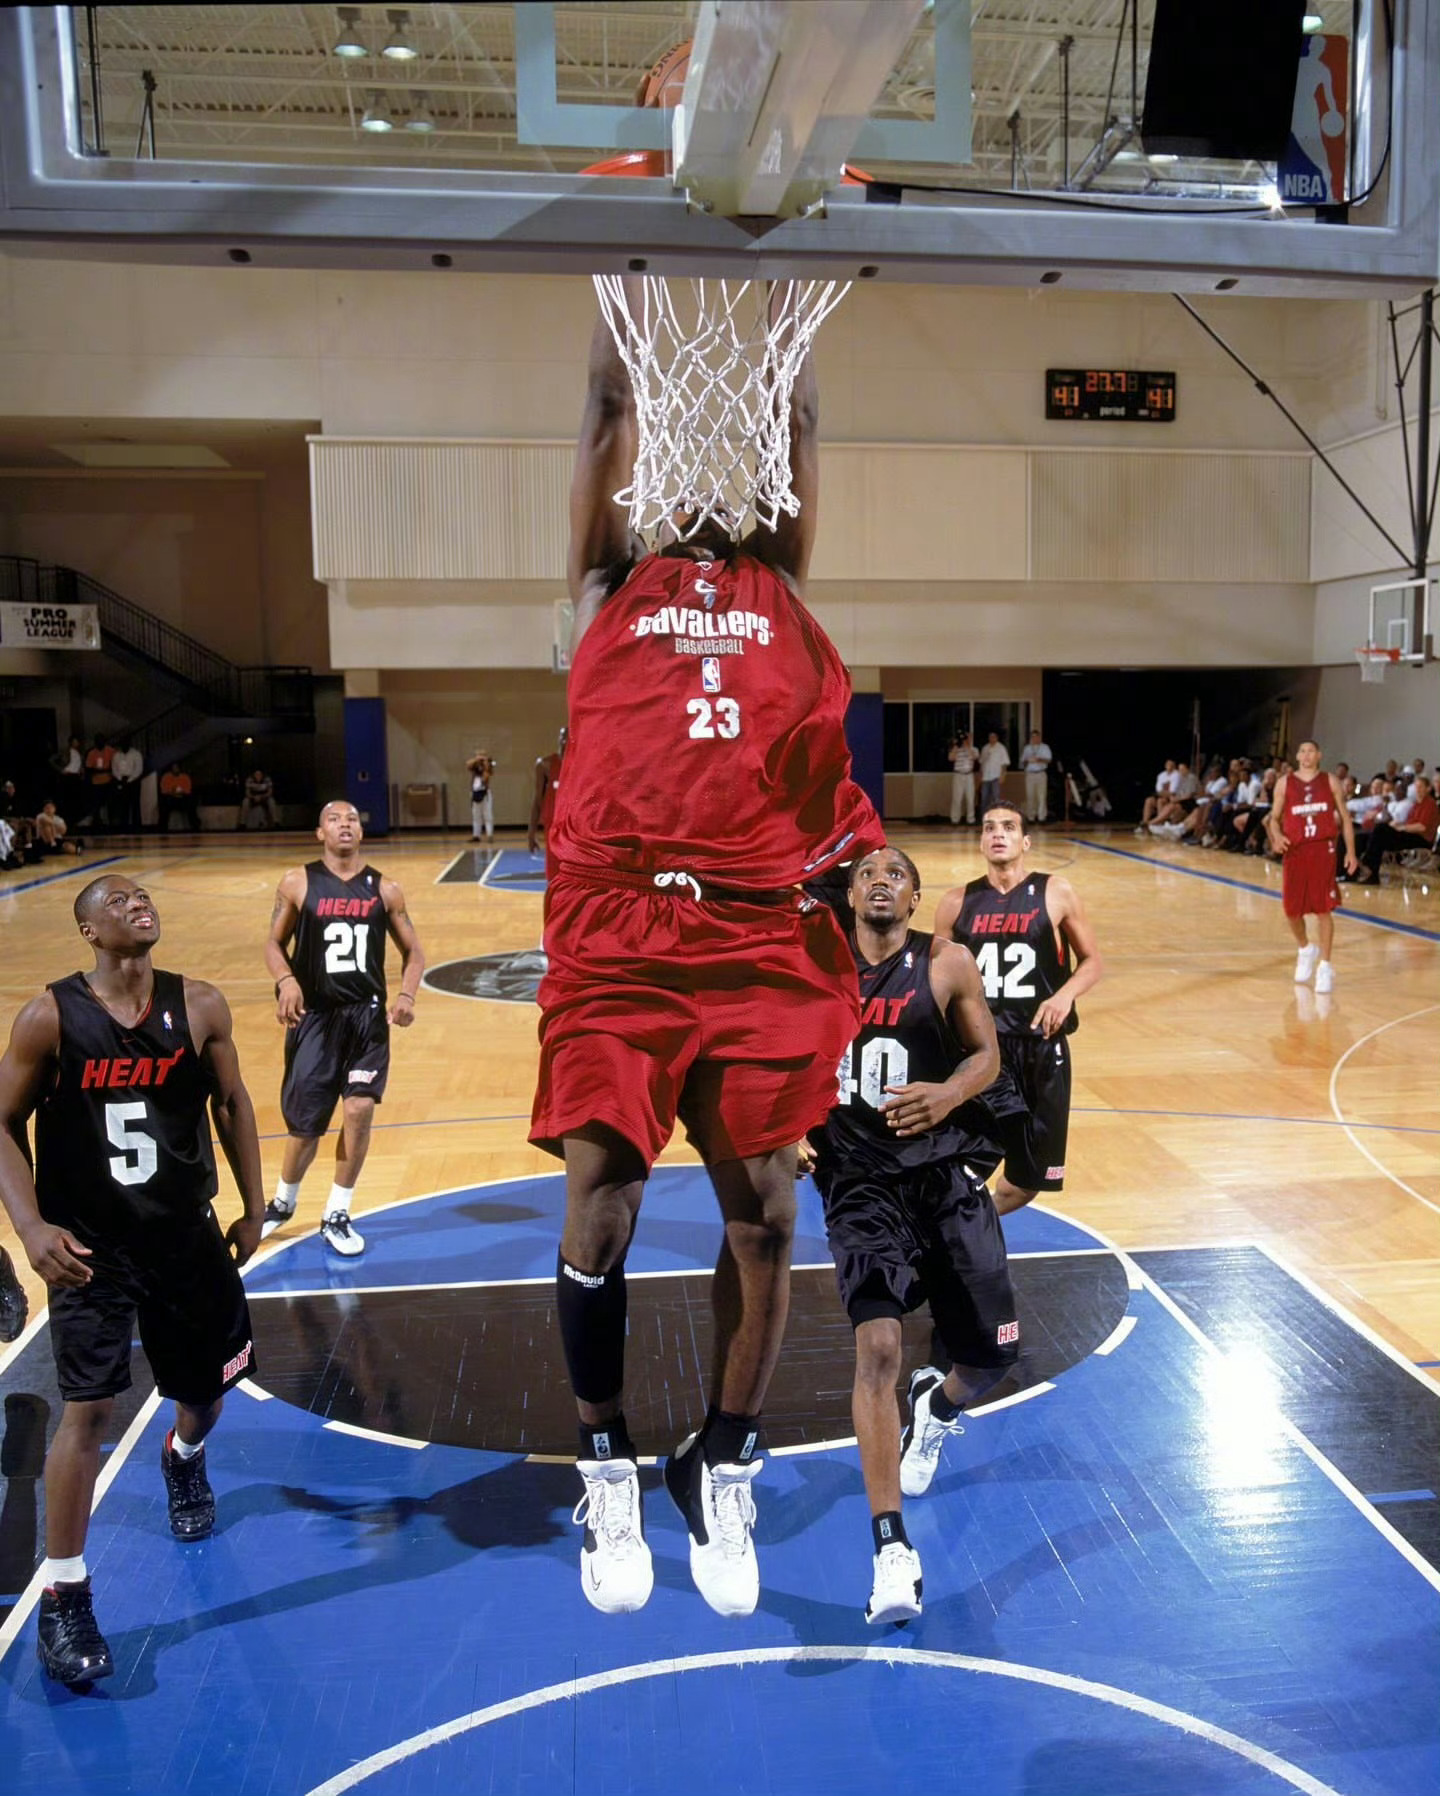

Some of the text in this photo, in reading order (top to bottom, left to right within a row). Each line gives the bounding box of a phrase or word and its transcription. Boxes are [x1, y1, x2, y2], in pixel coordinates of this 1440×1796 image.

[1284, 174, 1323, 198] NBA
[1054, 386, 1079, 407] 41
[1148, 388, 1173, 409] 41
[23, 618, 77, 629] SUMMER
[31, 607, 67, 619] PRO
[26, 627, 74, 638] LEAGUE
[685, 696, 741, 739] 23
[1304, 823, 1317, 838] 17
[316, 896, 378, 917] HEAT
[971, 907, 1040, 934] HEAT
[323, 921, 369, 974] 21
[975, 941, 1036, 998] 42
[81, 1046, 185, 1089] HEAT
[104, 1100, 158, 1186] 5
[222, 1339, 252, 1385] HEAT
